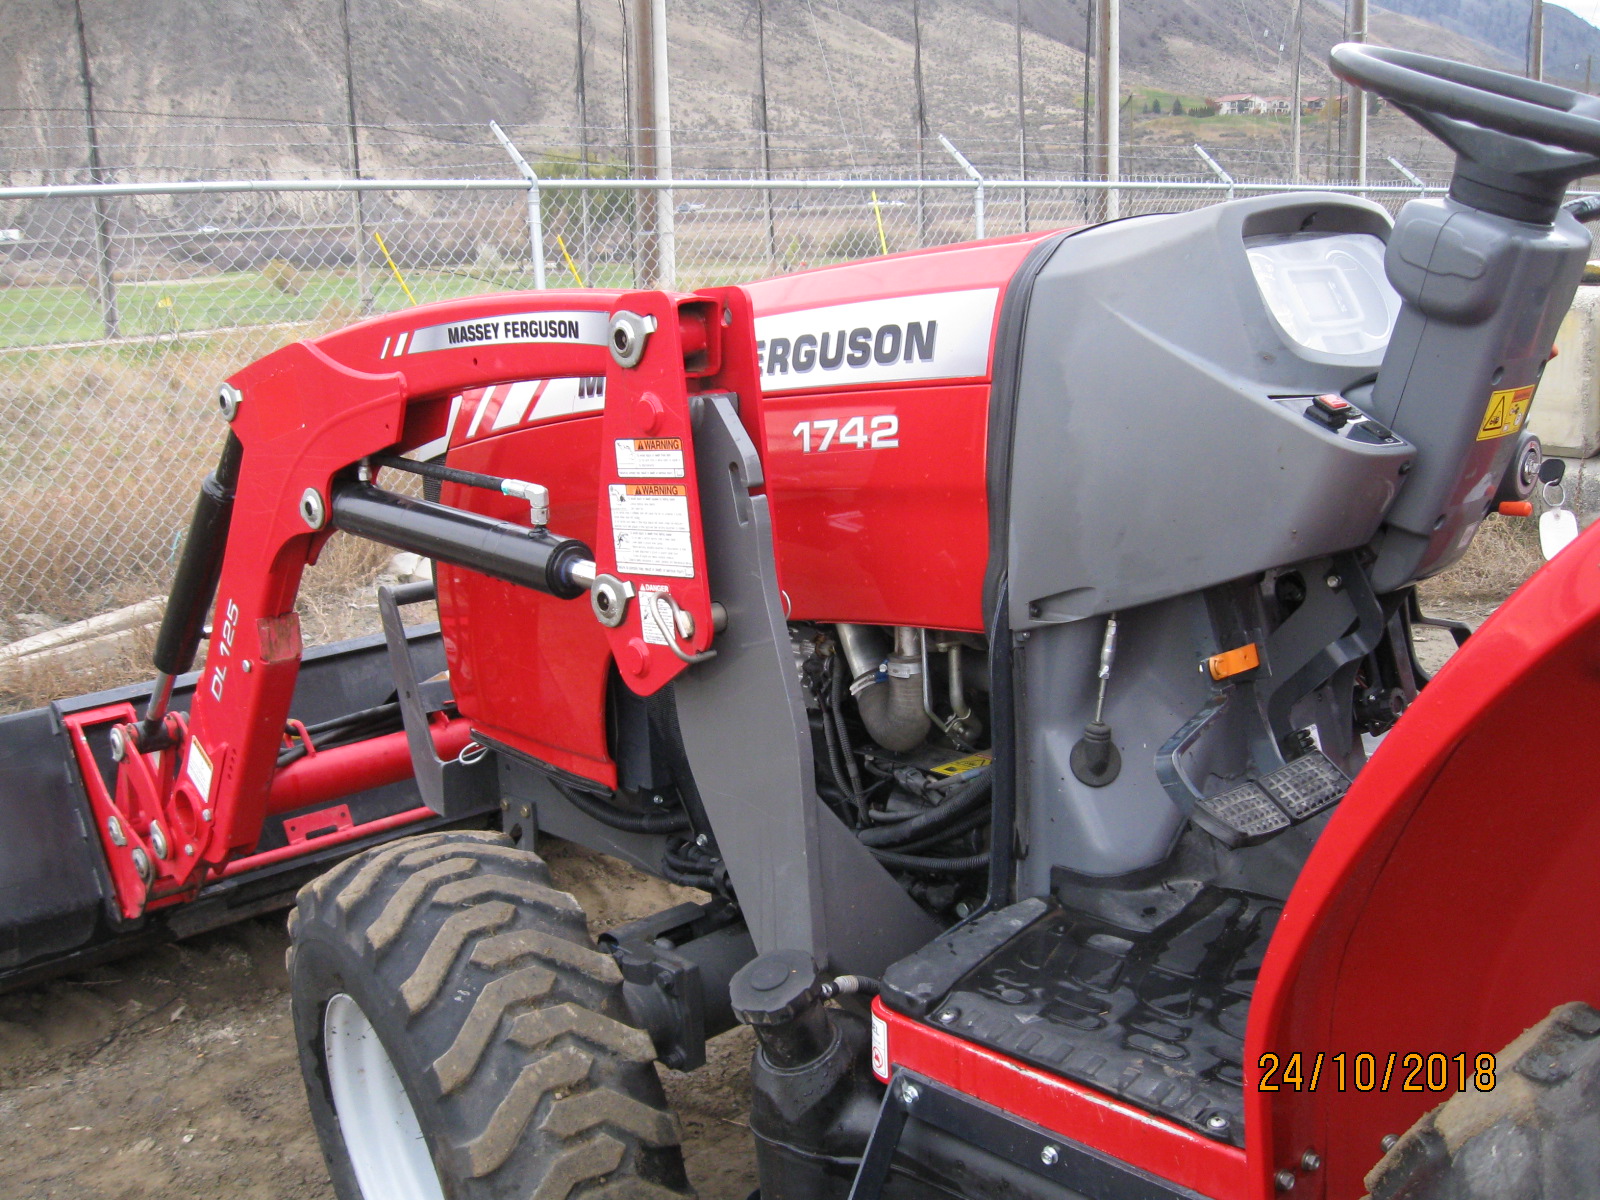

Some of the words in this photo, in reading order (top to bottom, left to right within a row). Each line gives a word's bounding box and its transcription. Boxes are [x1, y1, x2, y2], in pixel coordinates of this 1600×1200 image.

[447, 322, 500, 344] MASSEY
[504, 320, 579, 340] FERGUSON
[792, 414, 899, 453] 1742
[644, 440, 680, 450] WARNING
[643, 485, 679, 495] WARNING
[645, 584, 669, 592] DANGER
[210, 666, 227, 703] DL
[220, 599, 239, 656] 125
